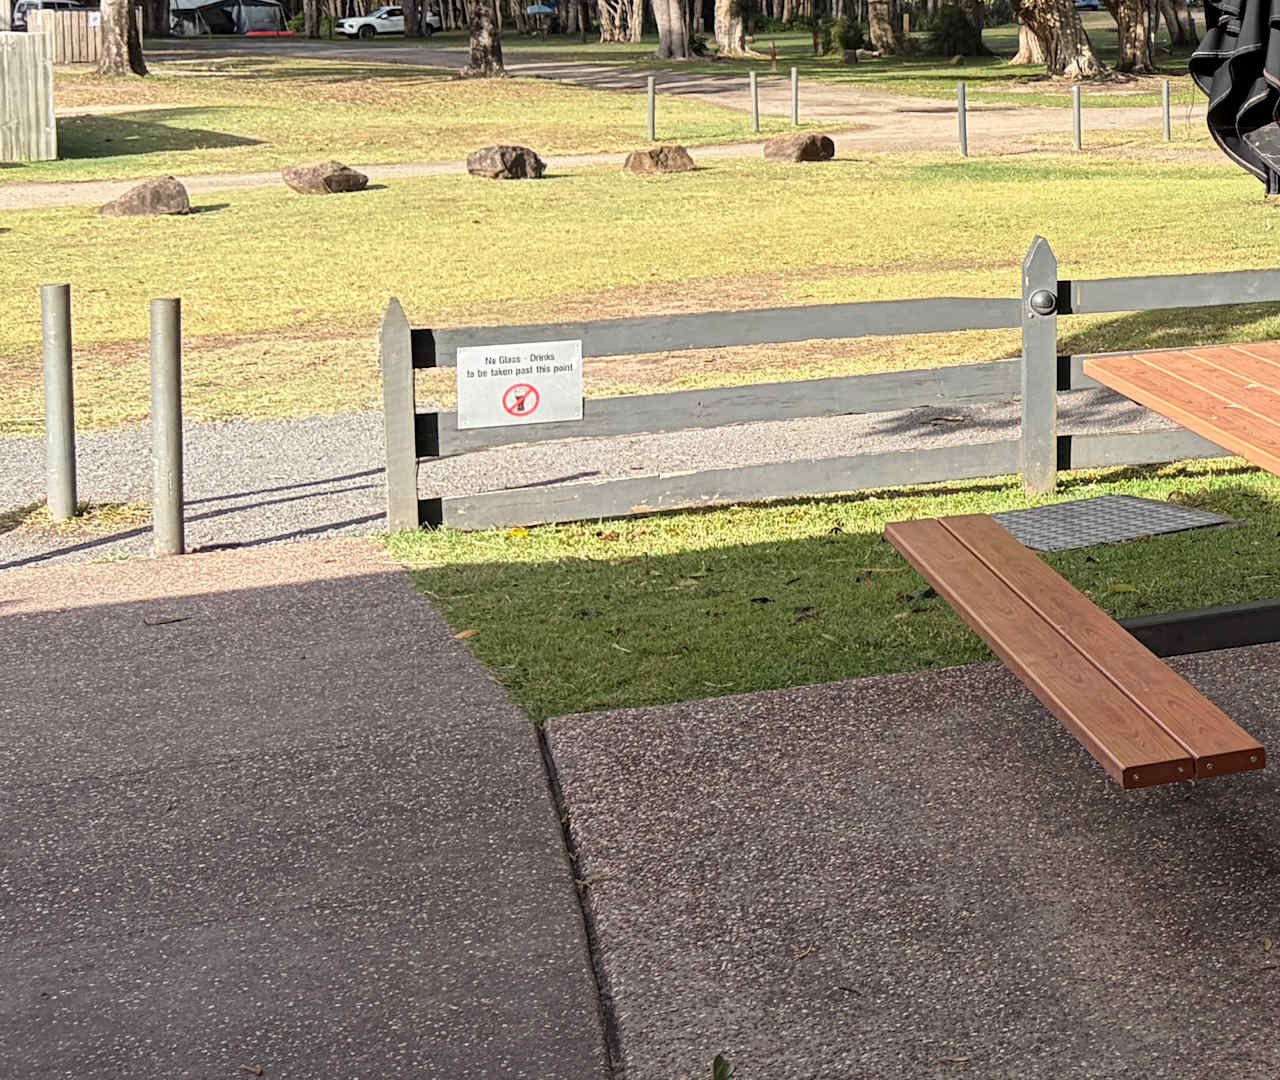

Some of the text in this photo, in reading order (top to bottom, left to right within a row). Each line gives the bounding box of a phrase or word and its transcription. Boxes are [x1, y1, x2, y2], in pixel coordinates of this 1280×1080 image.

[485, 356, 496, 365] No
[499, 355, 520, 364] Glass
[529, 352, 555, 362] Drinks
[467, 363, 572, 378] to be taken past this point
